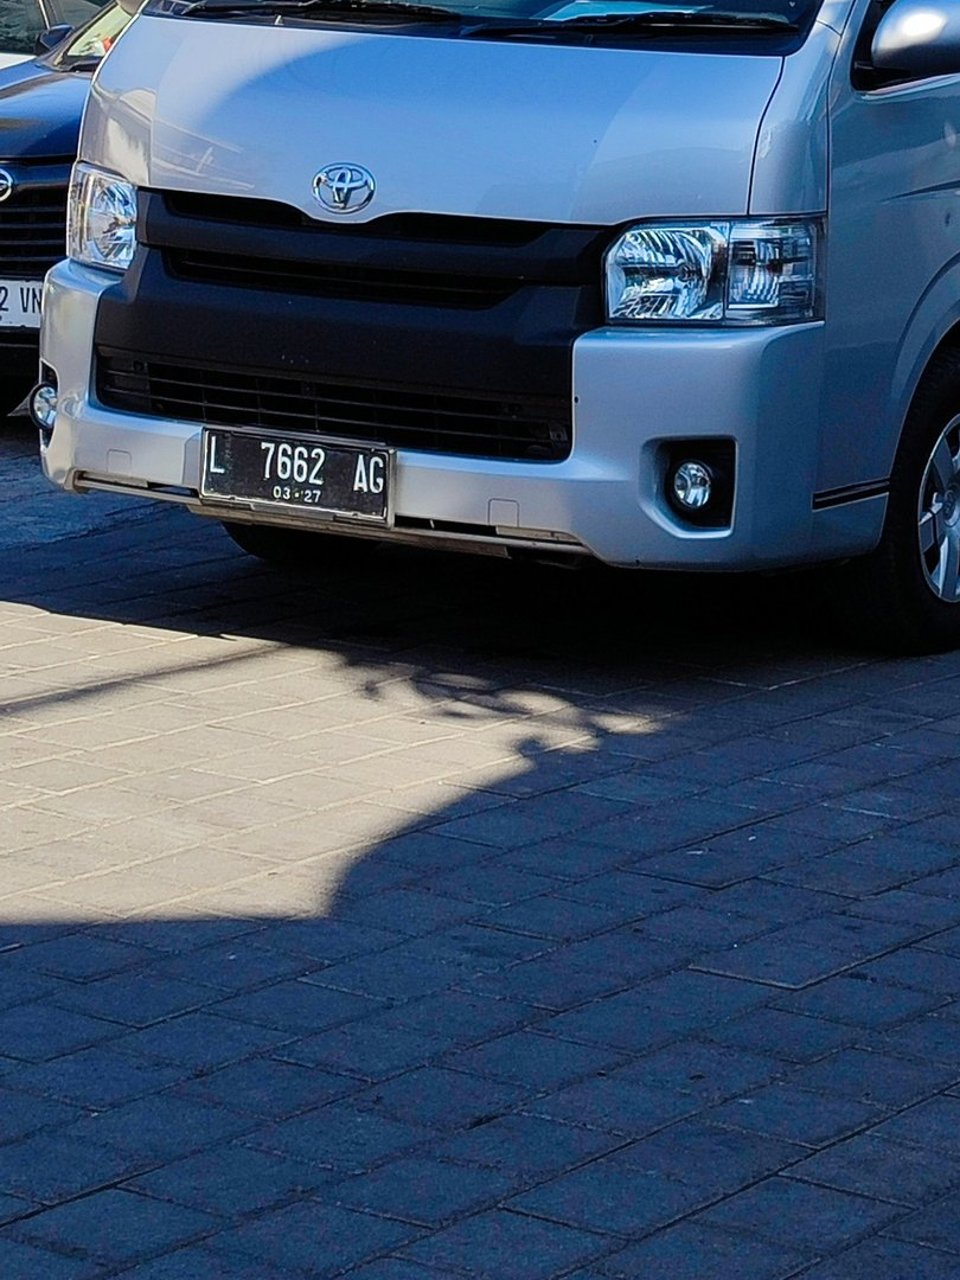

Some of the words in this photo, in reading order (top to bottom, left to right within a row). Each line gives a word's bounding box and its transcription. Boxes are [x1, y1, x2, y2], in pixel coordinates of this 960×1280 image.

[210, 436, 225, 474] L
[261, 441, 325, 486] 7662
[353, 454, 384, 494] AG
